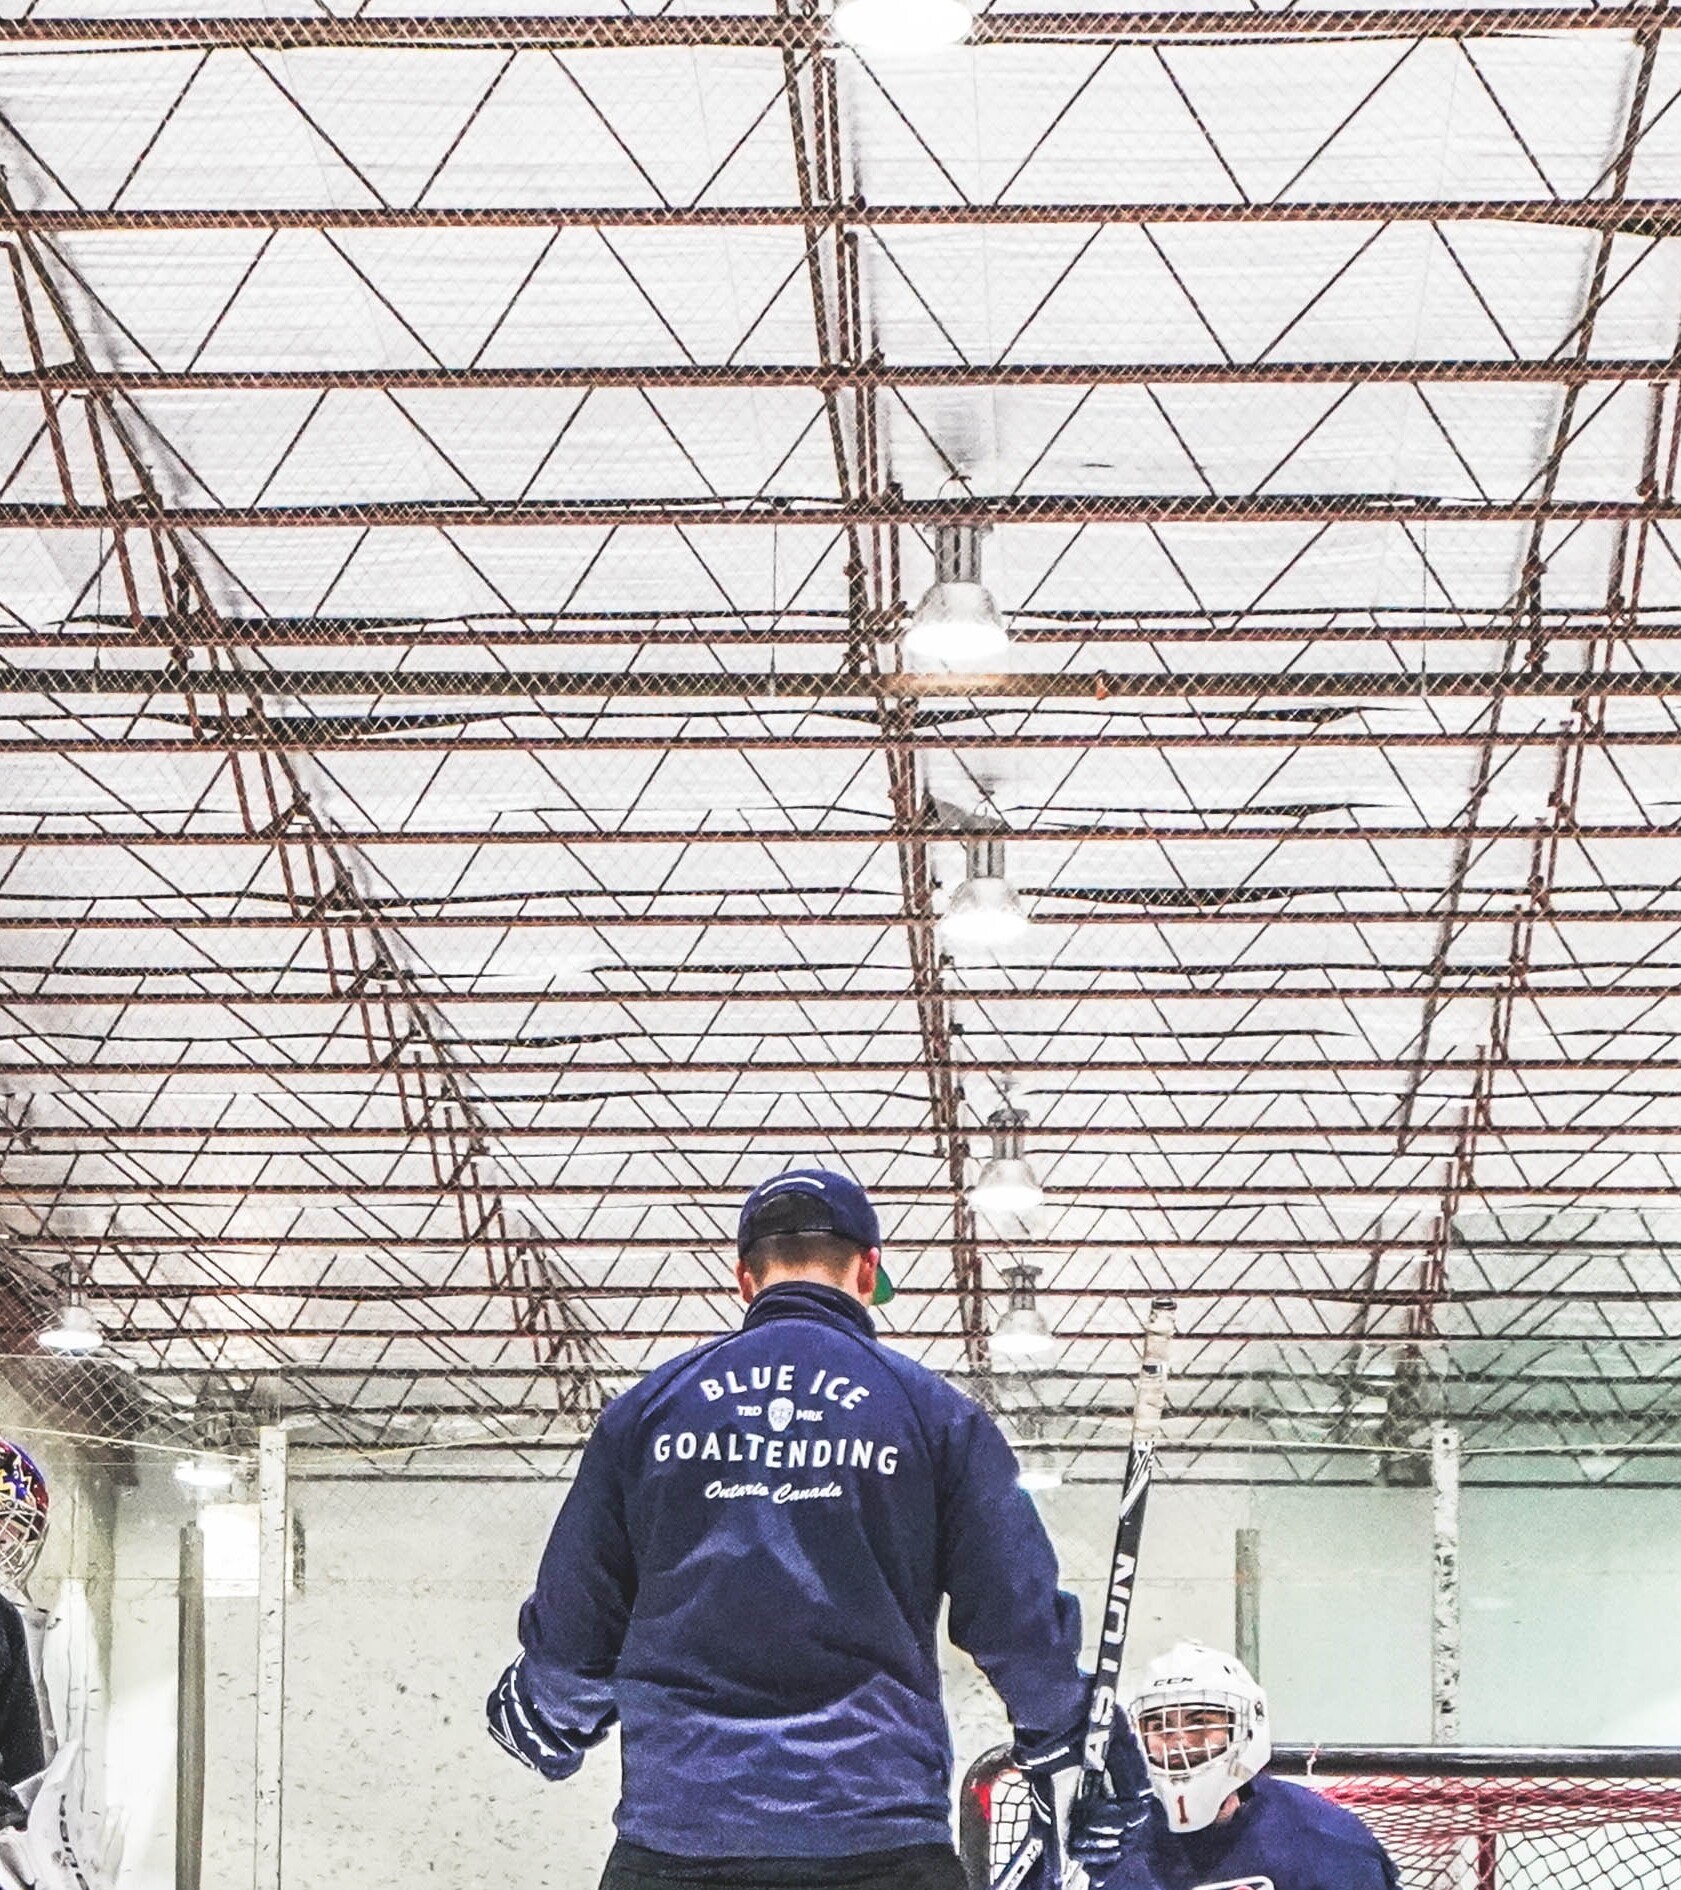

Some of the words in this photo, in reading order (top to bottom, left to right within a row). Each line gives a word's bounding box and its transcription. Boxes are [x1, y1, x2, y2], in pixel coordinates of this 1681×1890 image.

[700, 1365, 795, 1401] BLUE
[810, 1369, 870, 1410] ICE
[736, 1405, 762, 1417] TRD
[796, 1409, 823, 1422] MRK
[654, 1432, 899, 1475] GOALTENDING
[705, 1481, 769, 1499] Ontario
[773, 1482, 842, 1504] Canada
[1177, 1795, 1189, 1824] 1
